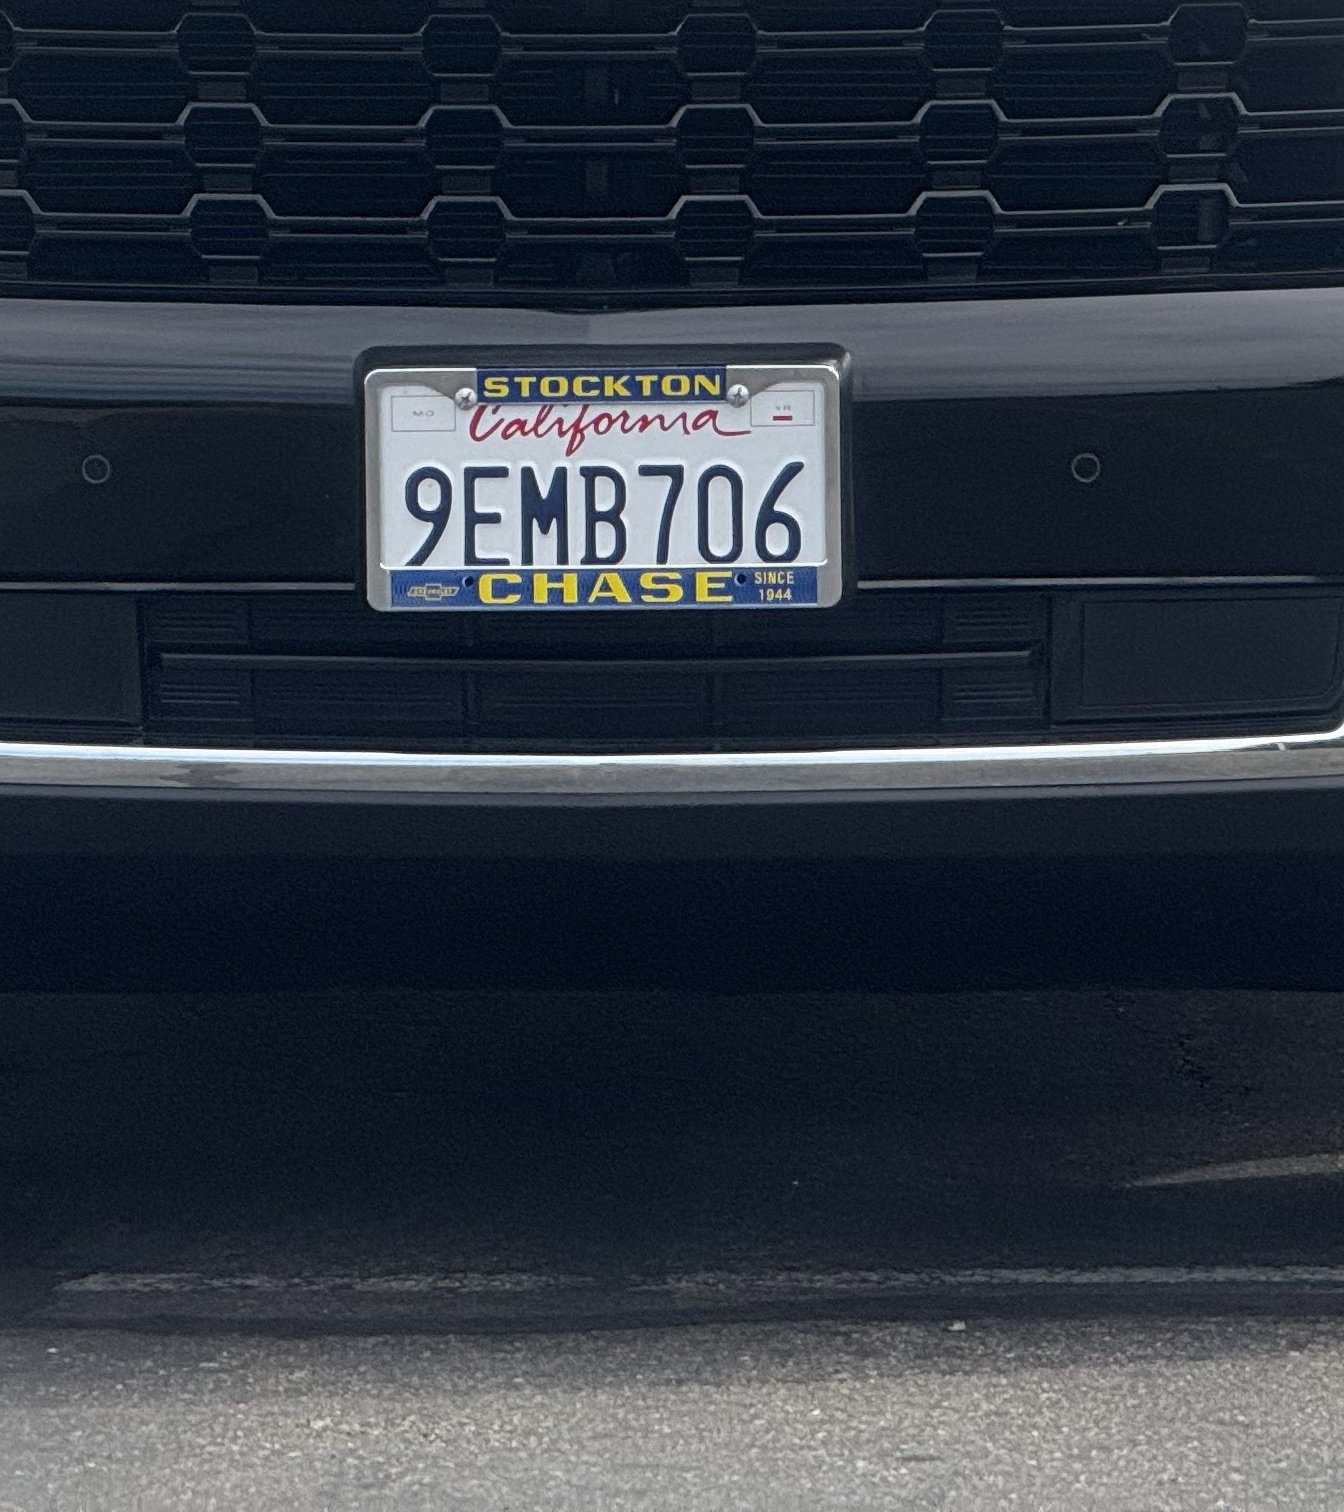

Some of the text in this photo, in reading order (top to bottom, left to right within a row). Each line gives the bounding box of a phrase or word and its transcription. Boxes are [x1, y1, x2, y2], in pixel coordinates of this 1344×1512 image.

[483, 374, 722, 399] STOCKTON
[468, 402, 752, 457] California
[403, 460, 806, 568] 9EMB706
[478, 570, 735, 605] CHASE
[754, 571, 795, 585] SINCE
[758, 588, 793, 601] 1944
